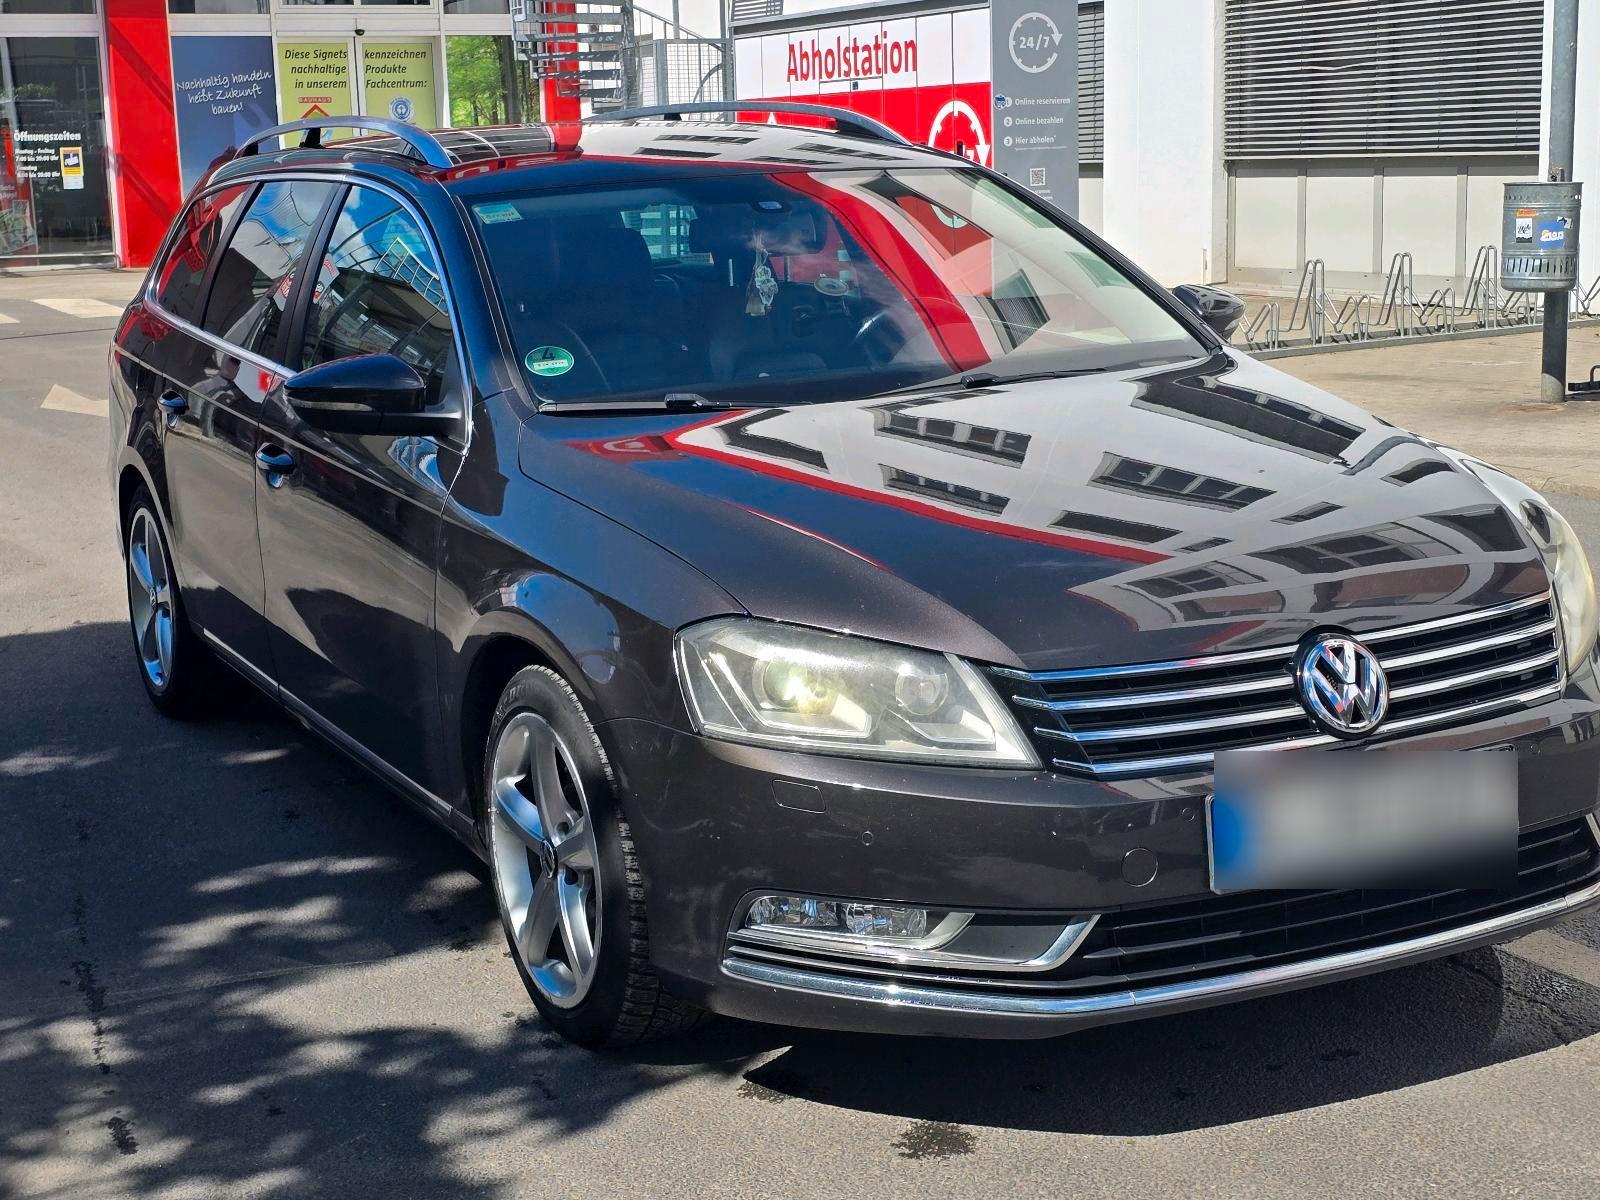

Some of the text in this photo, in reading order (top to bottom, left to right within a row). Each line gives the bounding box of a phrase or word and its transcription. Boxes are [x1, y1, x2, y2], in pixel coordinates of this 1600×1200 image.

[1019, 34, 1050, 50] 24/7
[285, 50, 427, 61] Diese Signets kennzeichnen
[787, 31, 917, 82] Abholstation
[291, 64, 407, 75] nachhaltige Produkte
[176, 69, 272, 91] Nachhaltig handeln
[294, 79, 427, 89] in unserem Fachcentrum:
[187, 83, 263, 104] heißt Zukunft
[1015, 97, 1034, 105] Online
[1036, 97, 1071, 105] reservieren
[211, 101, 244, 115] bauen!
[1015, 117, 1033, 125] Online
[1036, 116, 1064, 125] bezahlen
[14, 130, 81, 143] Öffnungszeiten
[1015, 136, 1028, 145] Hier
[541, 347, 555, 360] 4
